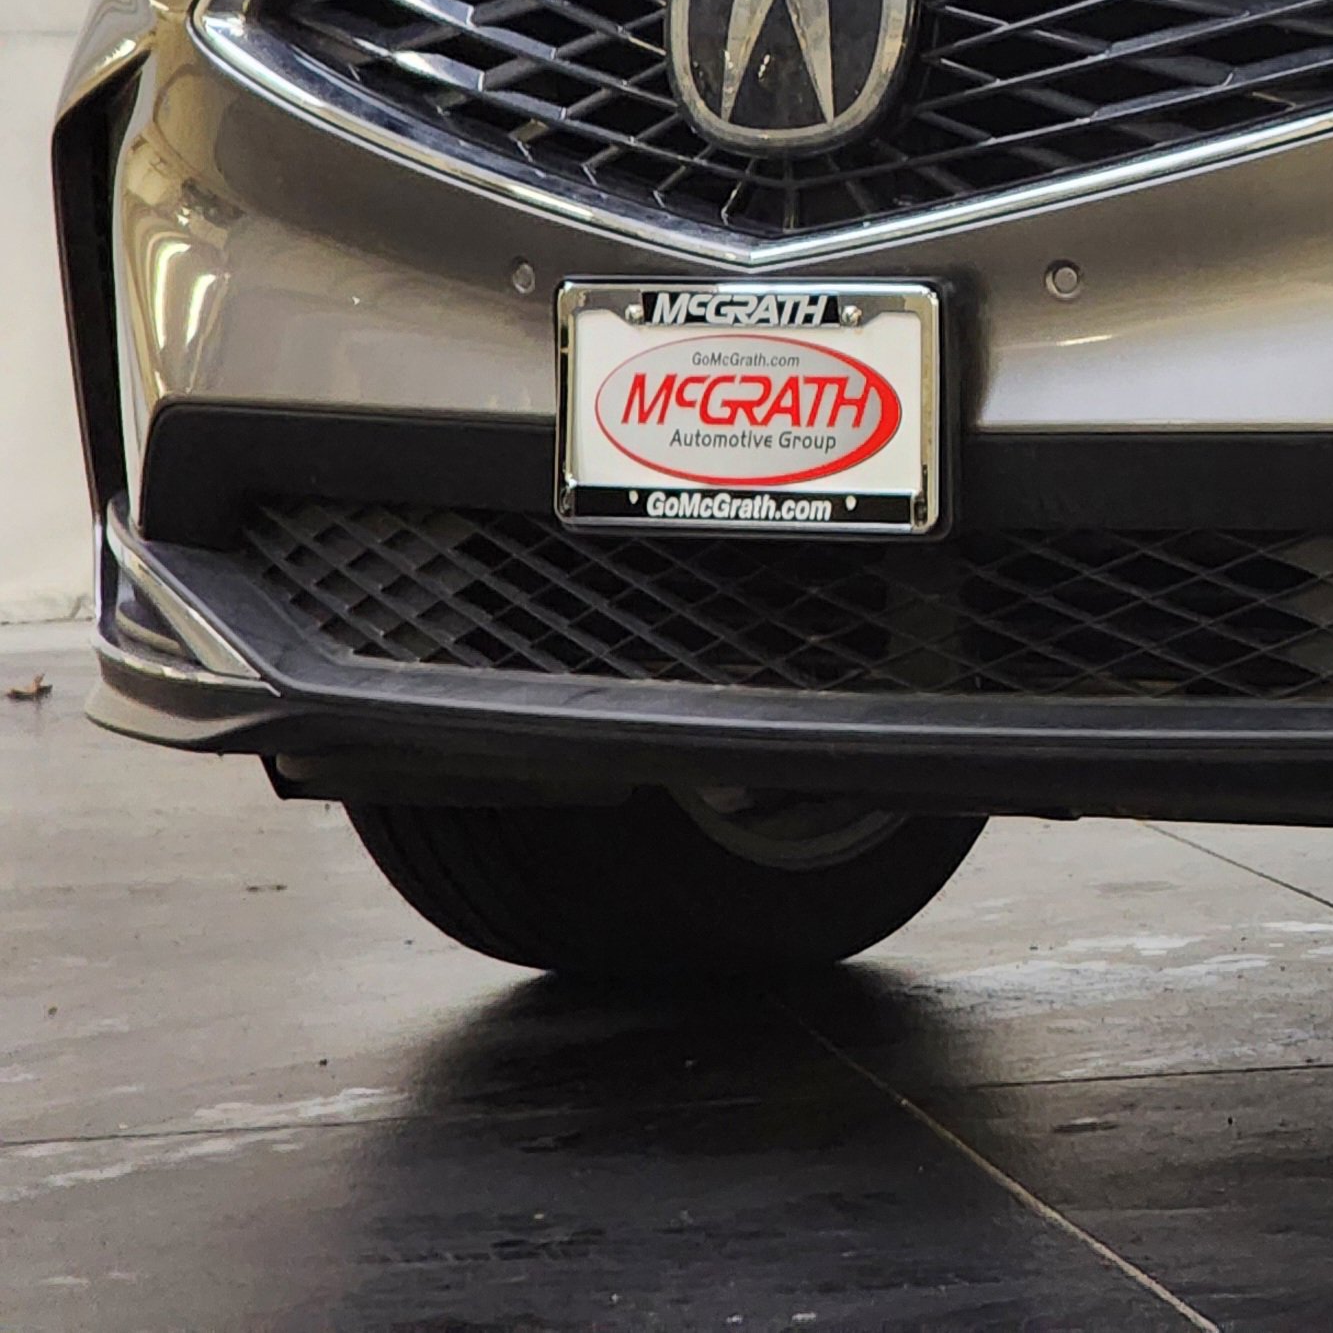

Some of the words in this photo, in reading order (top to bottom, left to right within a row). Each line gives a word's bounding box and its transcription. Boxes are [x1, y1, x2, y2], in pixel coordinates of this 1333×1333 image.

[691, 351, 800, 368] GoMcGrath.com
[669, 429, 773, 449] Automotive
[778, 430, 837, 454] Group
[646, 491, 832, 522] GoMcGrath.com
